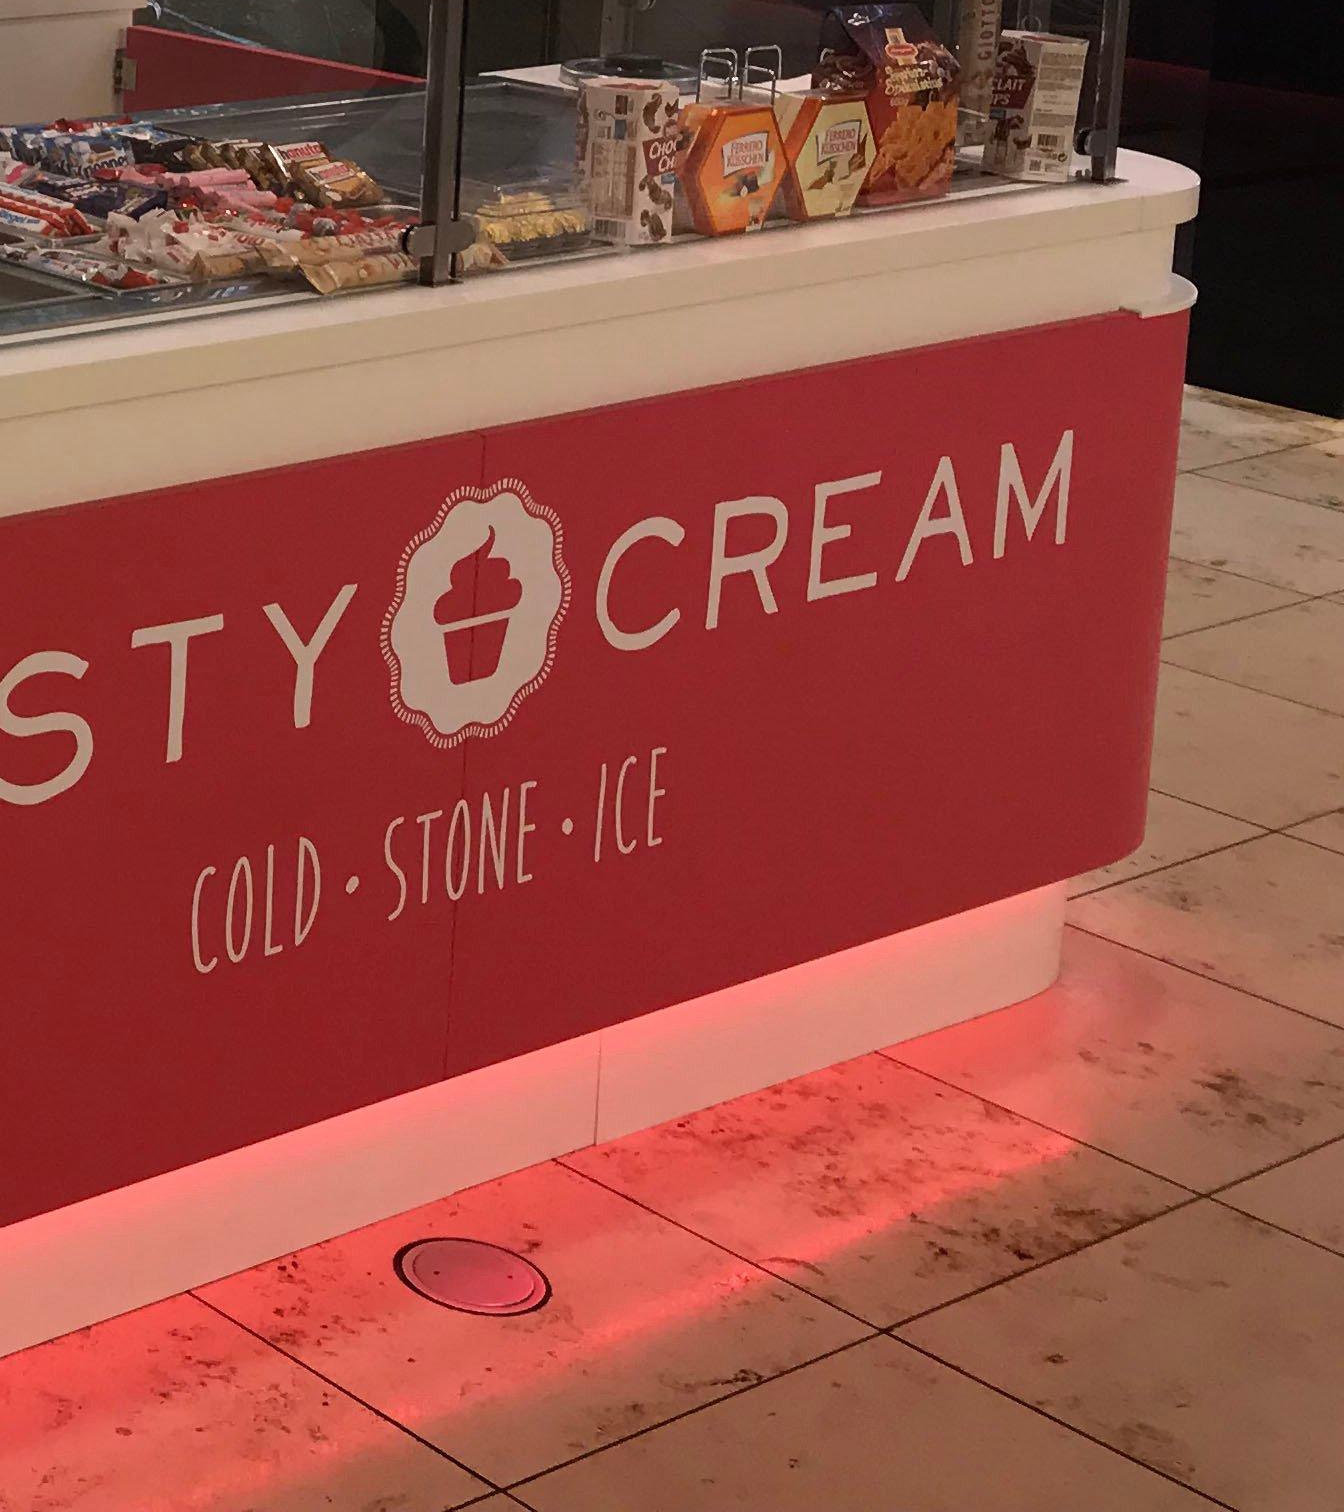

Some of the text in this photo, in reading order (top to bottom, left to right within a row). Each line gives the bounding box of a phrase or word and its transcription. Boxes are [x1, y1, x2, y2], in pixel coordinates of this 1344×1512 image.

[596, 429, 1074, 651] CREAM
[192, 747, 667, 973] COLD STONE ICE
